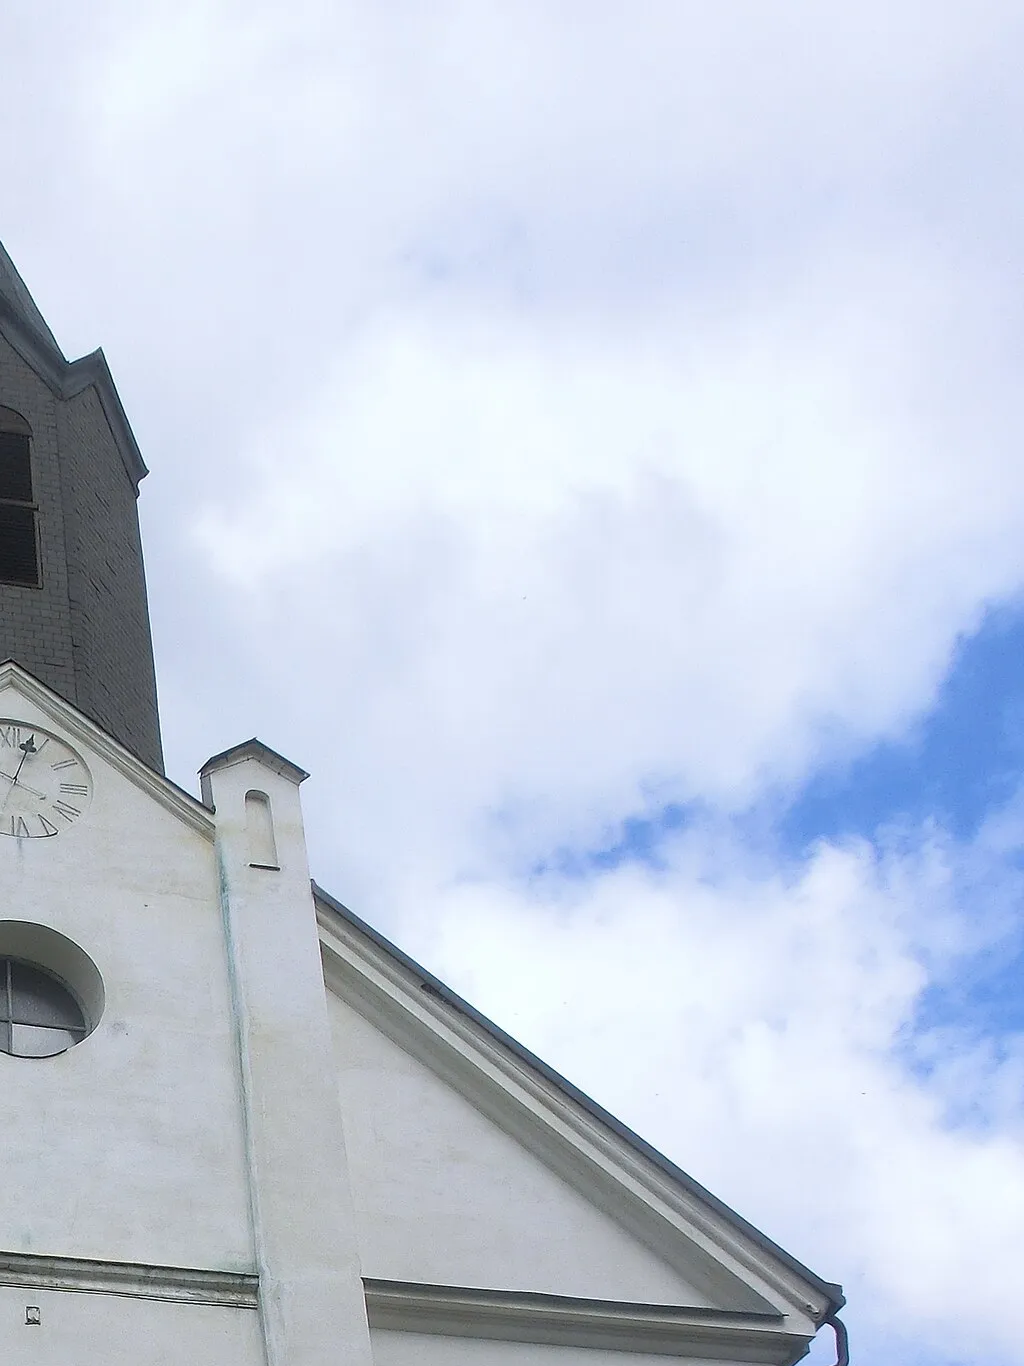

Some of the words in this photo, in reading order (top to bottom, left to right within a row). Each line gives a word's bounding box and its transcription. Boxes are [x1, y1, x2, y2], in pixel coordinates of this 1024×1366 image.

[35, 738, 49, 754] I
[51, 759, 78, 771] II
[60, 783, 88, 796] III
[52, 800, 81, 822] IV
[11, 815, 30, 837] VI
[38, 814, 58, 834] V
